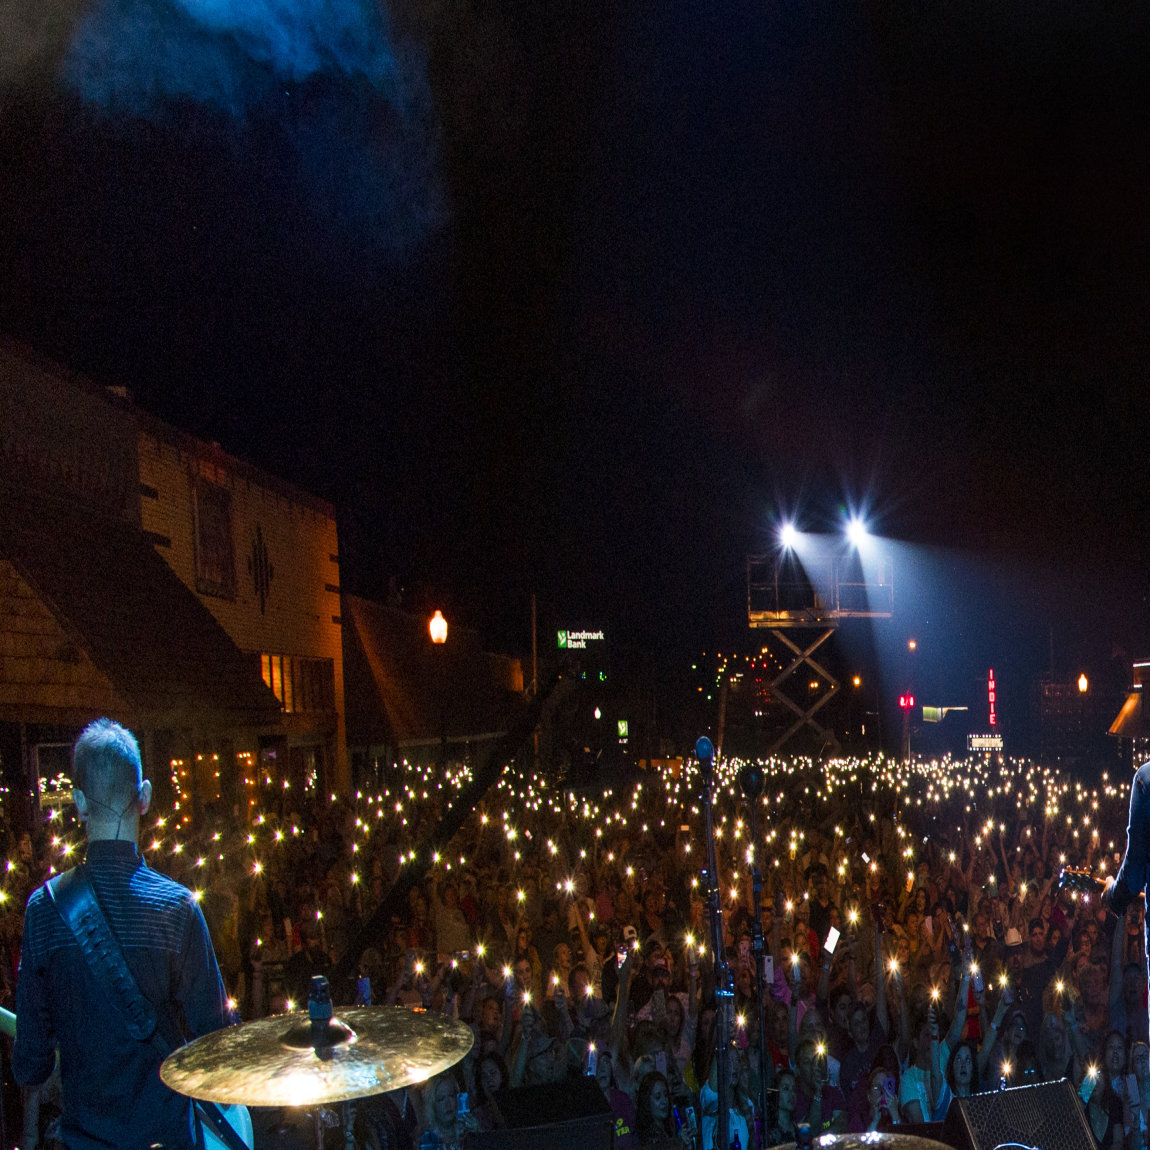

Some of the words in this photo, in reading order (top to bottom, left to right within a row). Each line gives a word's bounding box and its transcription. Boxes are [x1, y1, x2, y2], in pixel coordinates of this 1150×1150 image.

[567, 630, 604, 640] Landmark
[567, 639, 587, 649] Bank
[988, 667, 997, 726] INDIE
